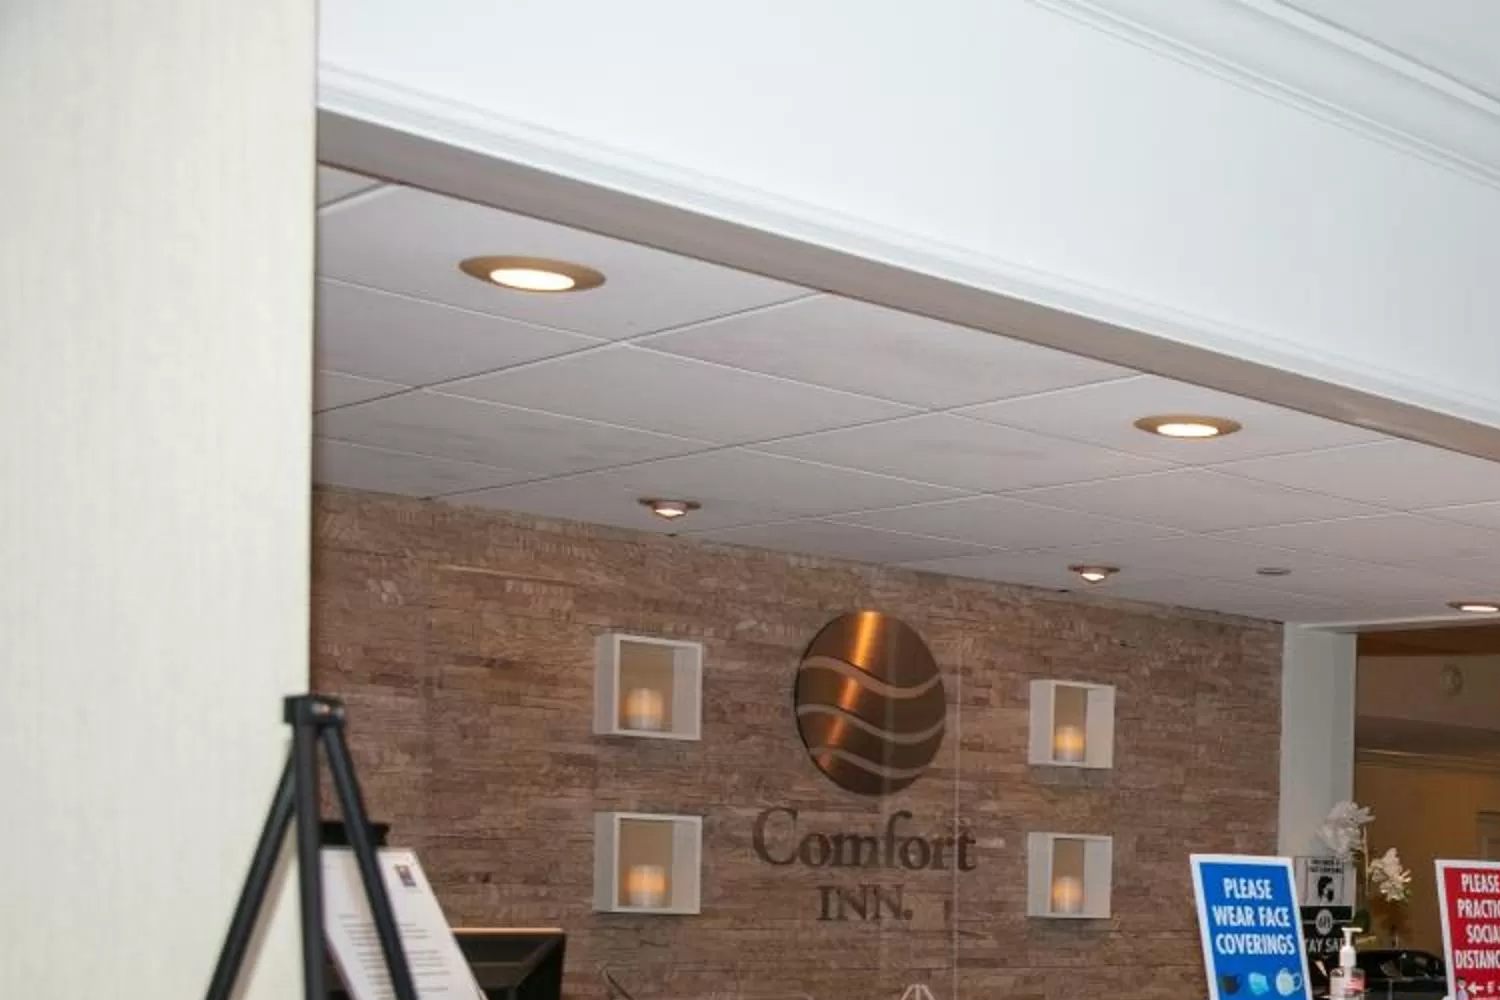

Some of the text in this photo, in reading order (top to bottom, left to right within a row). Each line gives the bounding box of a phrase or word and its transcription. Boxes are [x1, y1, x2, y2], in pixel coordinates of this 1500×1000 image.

[753, 806, 976, 872] Comfort
[1223, 877, 1272, 899] PLEASE
[1461, 873, 1500, 893] PLEASE
[1212, 904, 1290, 927] WEAR FACE
[1216, 932, 1296, 955] COVERINGS
